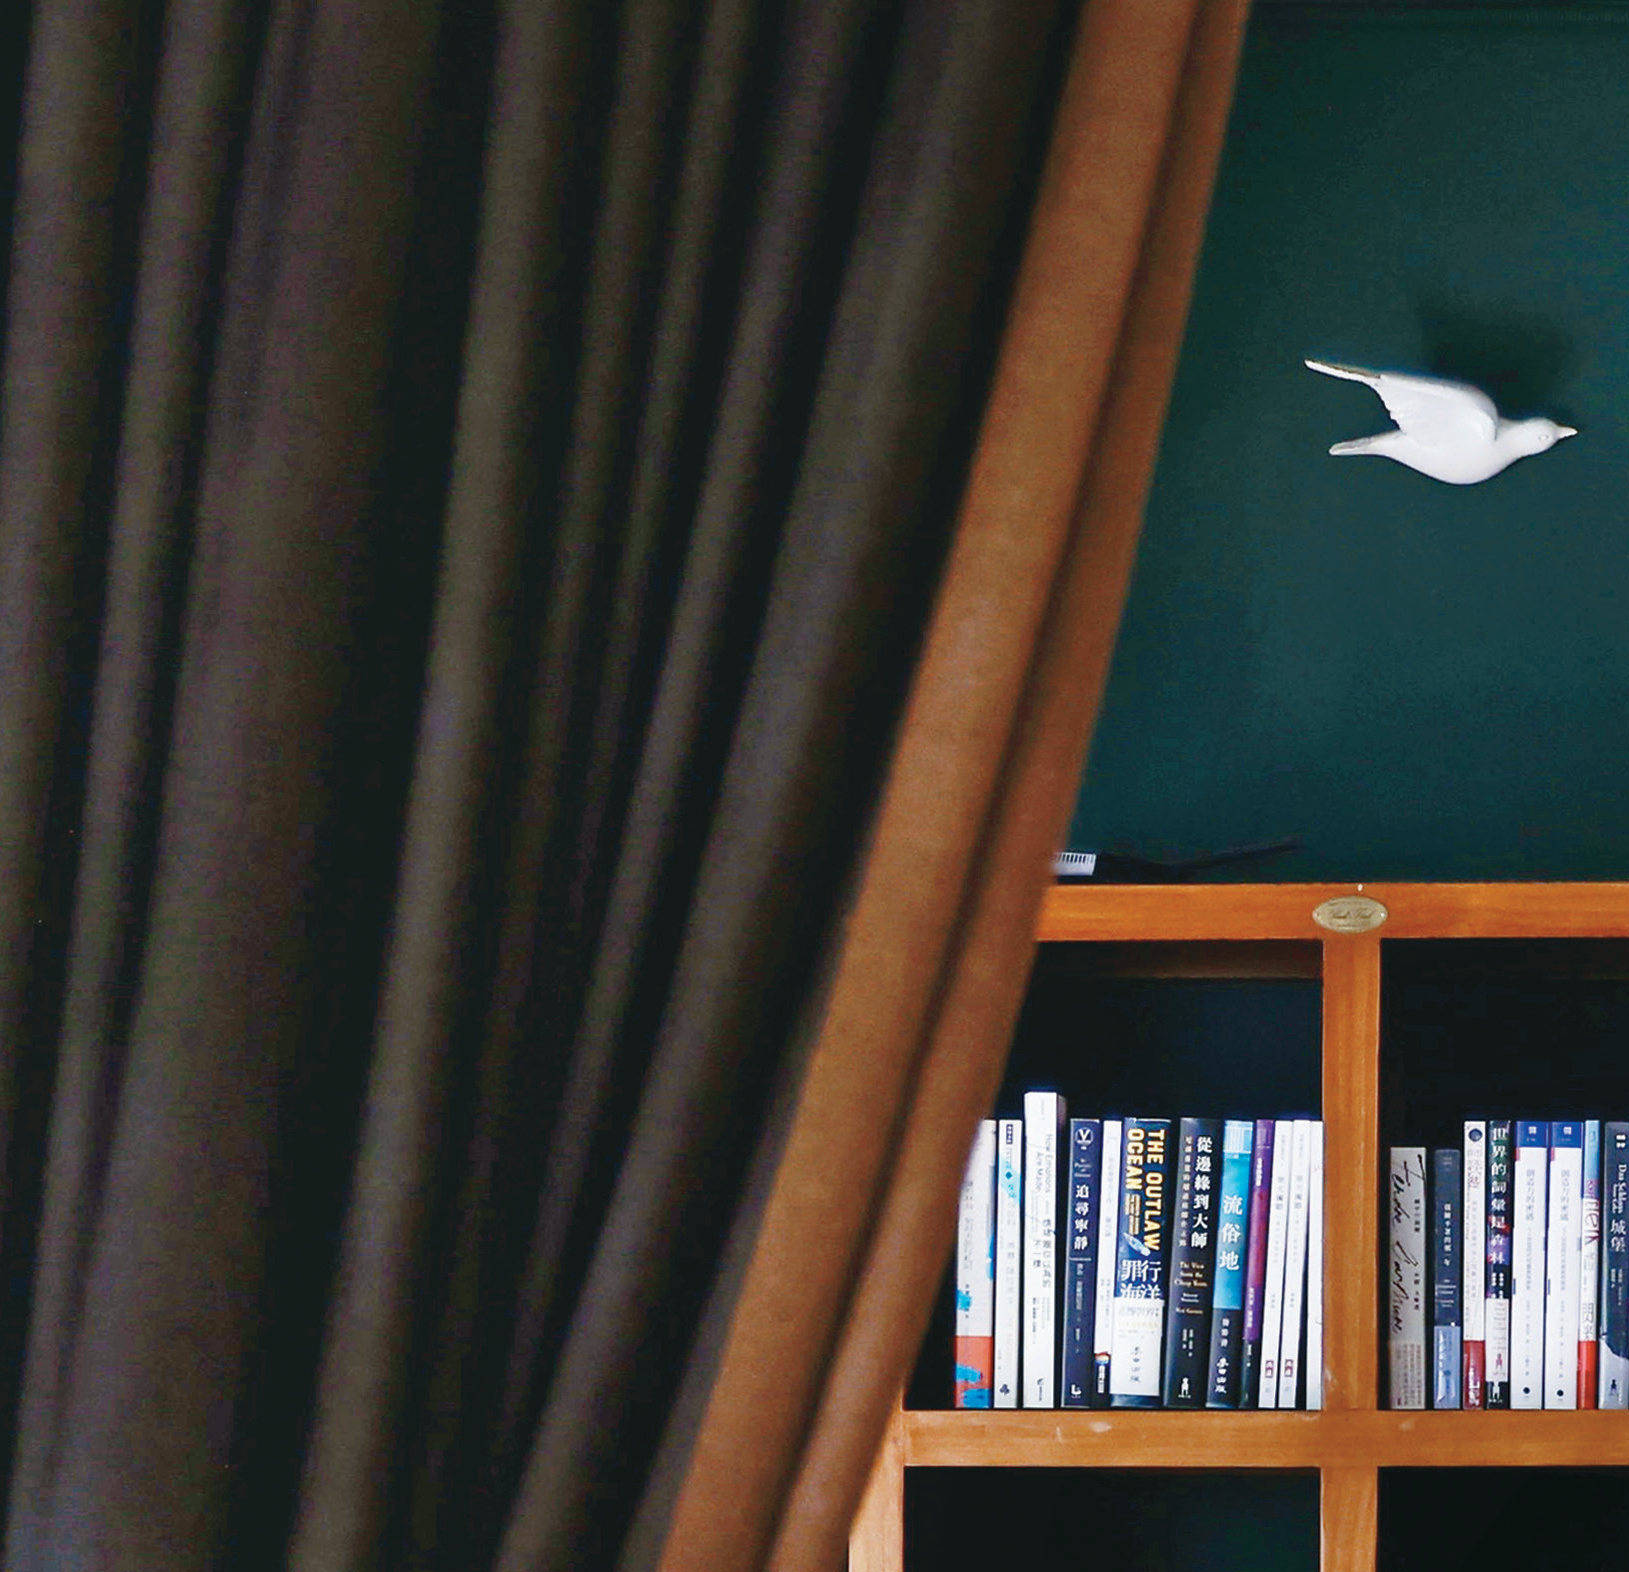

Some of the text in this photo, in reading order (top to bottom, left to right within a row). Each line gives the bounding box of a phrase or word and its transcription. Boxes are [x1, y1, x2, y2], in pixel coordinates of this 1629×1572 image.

[1125, 1127, 1145, 1190] OCEAN
[1143, 1128, 1166, 1252] THE OUTLAW
[1219, 1194, 1244, 1272] 流俗地
